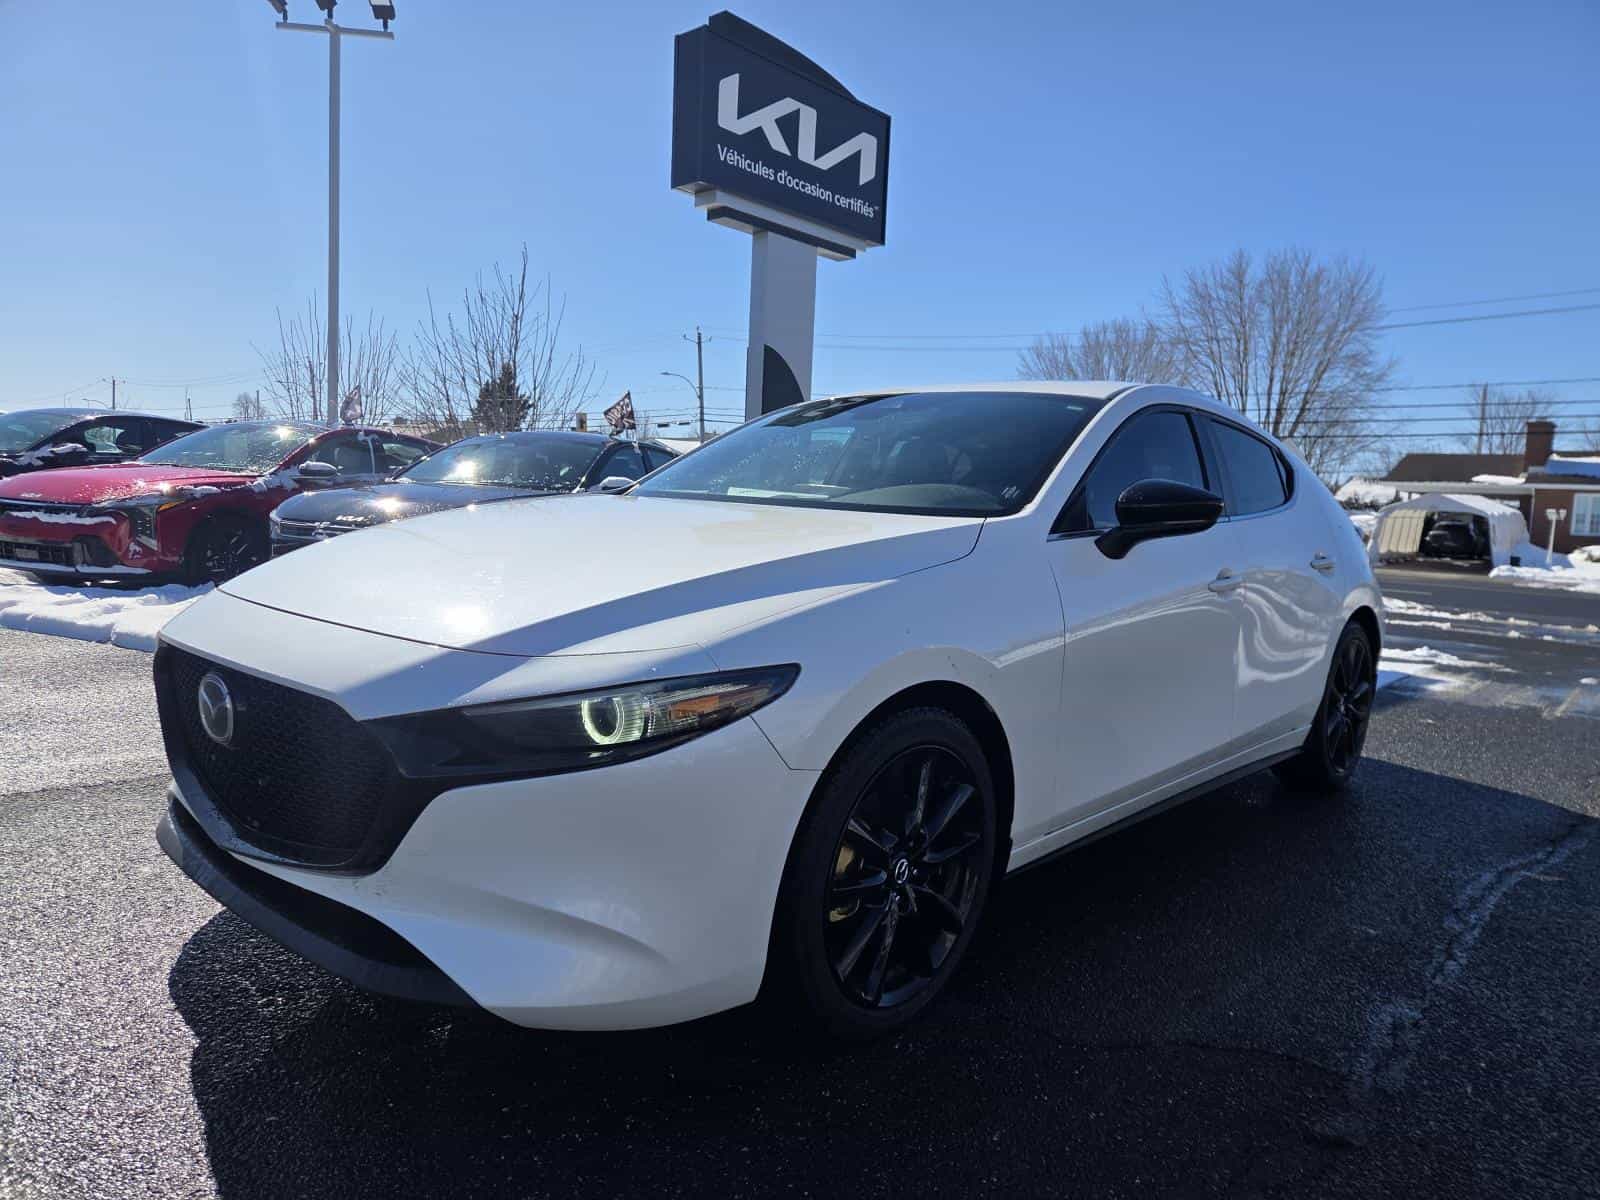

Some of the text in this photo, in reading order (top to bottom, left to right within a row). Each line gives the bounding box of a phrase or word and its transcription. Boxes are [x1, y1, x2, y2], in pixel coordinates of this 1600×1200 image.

[717, 73, 878, 186] KIA
[717, 143, 874, 218] Véhicules d'occasion certifiés
